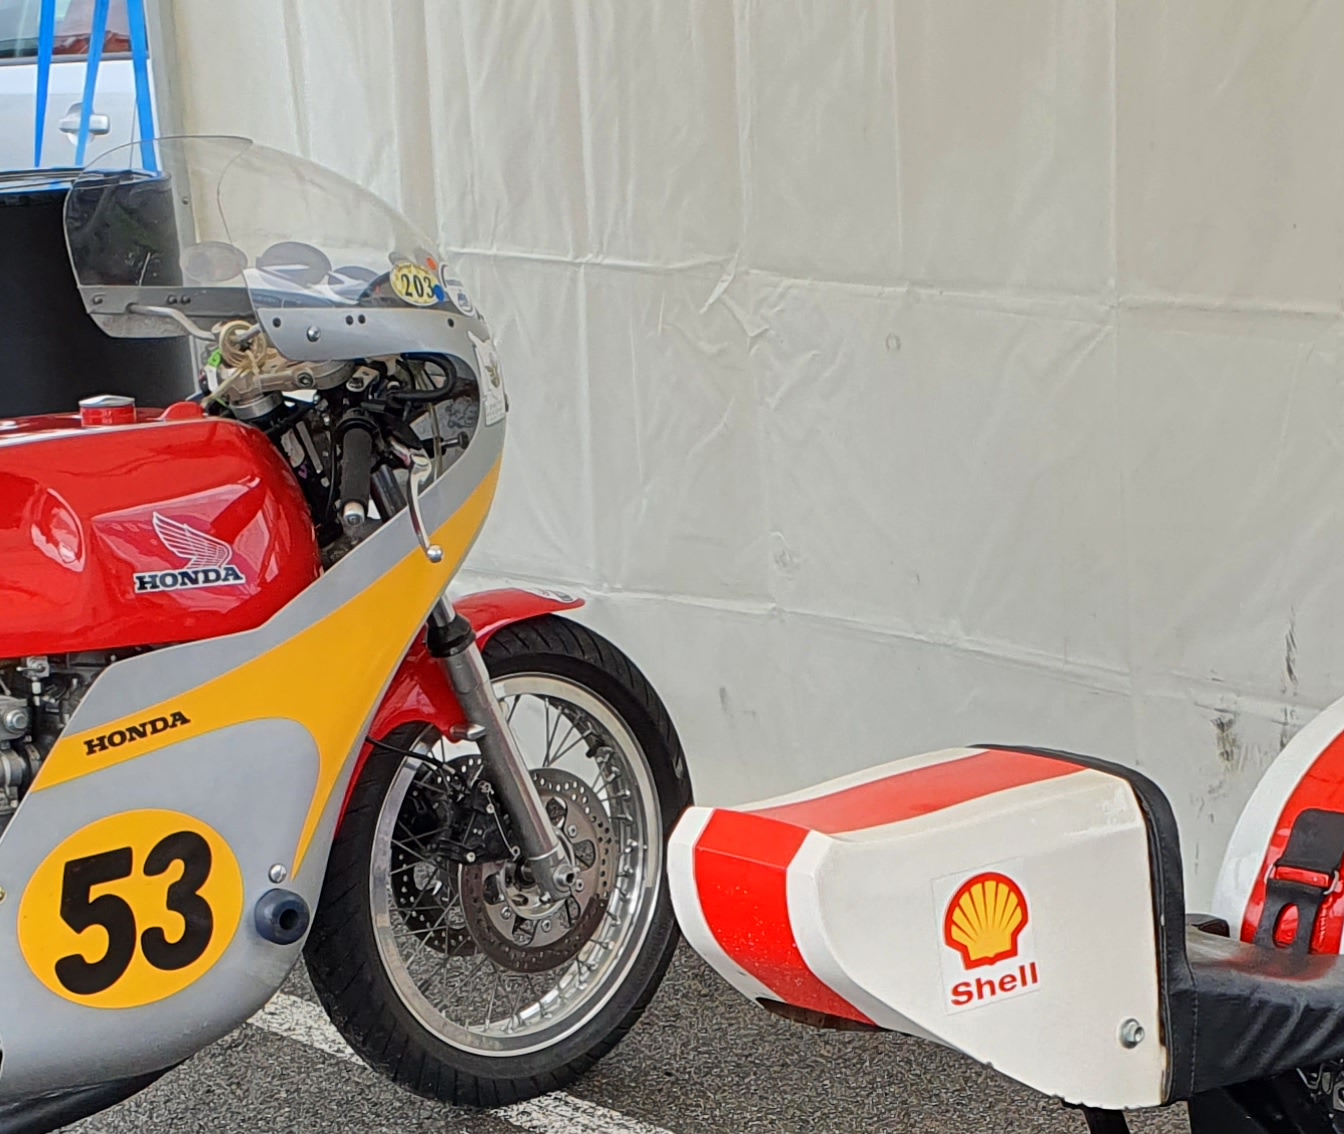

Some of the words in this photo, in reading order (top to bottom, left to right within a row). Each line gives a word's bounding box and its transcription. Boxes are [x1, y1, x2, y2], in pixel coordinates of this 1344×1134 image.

[400, 273, 434, 299] 203
[135, 566, 244, 592] HONDA
[83, 710, 191, 756] HONDA
[54, 830, 214, 995] 53
[951, 961, 1038, 1006] Shell
